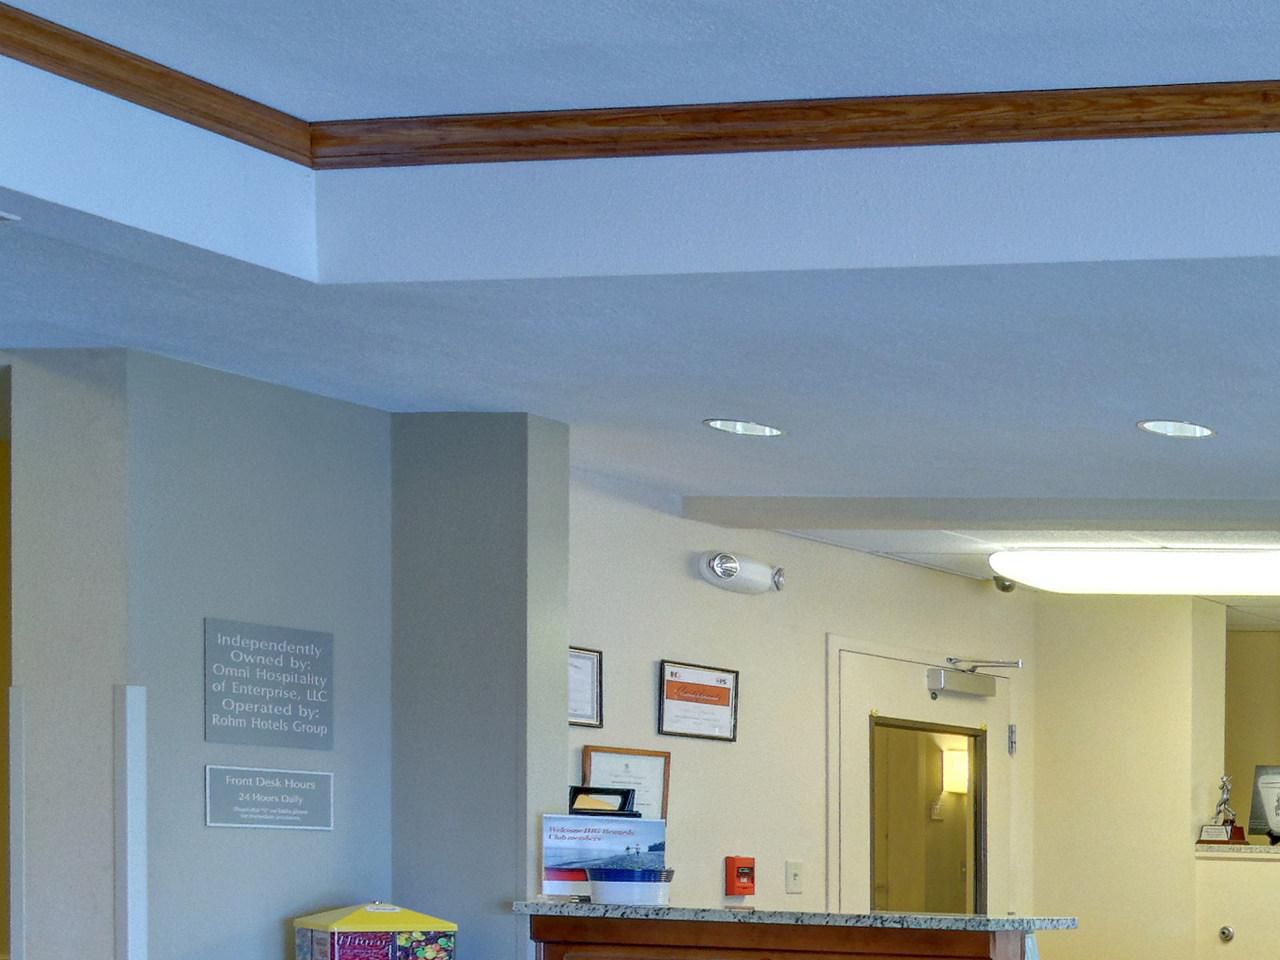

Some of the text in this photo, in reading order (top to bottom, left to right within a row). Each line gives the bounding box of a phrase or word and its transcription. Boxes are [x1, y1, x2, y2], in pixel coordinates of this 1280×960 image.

[217, 633, 322, 658] Independently
[230, 650, 311, 672] Owned by:
[212, 663, 327, 688] Omni Hospitality
[211, 680, 328, 702] of Enterprise, LLC
[222, 698, 320, 721] Operated by:
[212, 713, 328, 737] Rohm Hotels Group
[225, 775, 316, 790] Front Desk Hours
